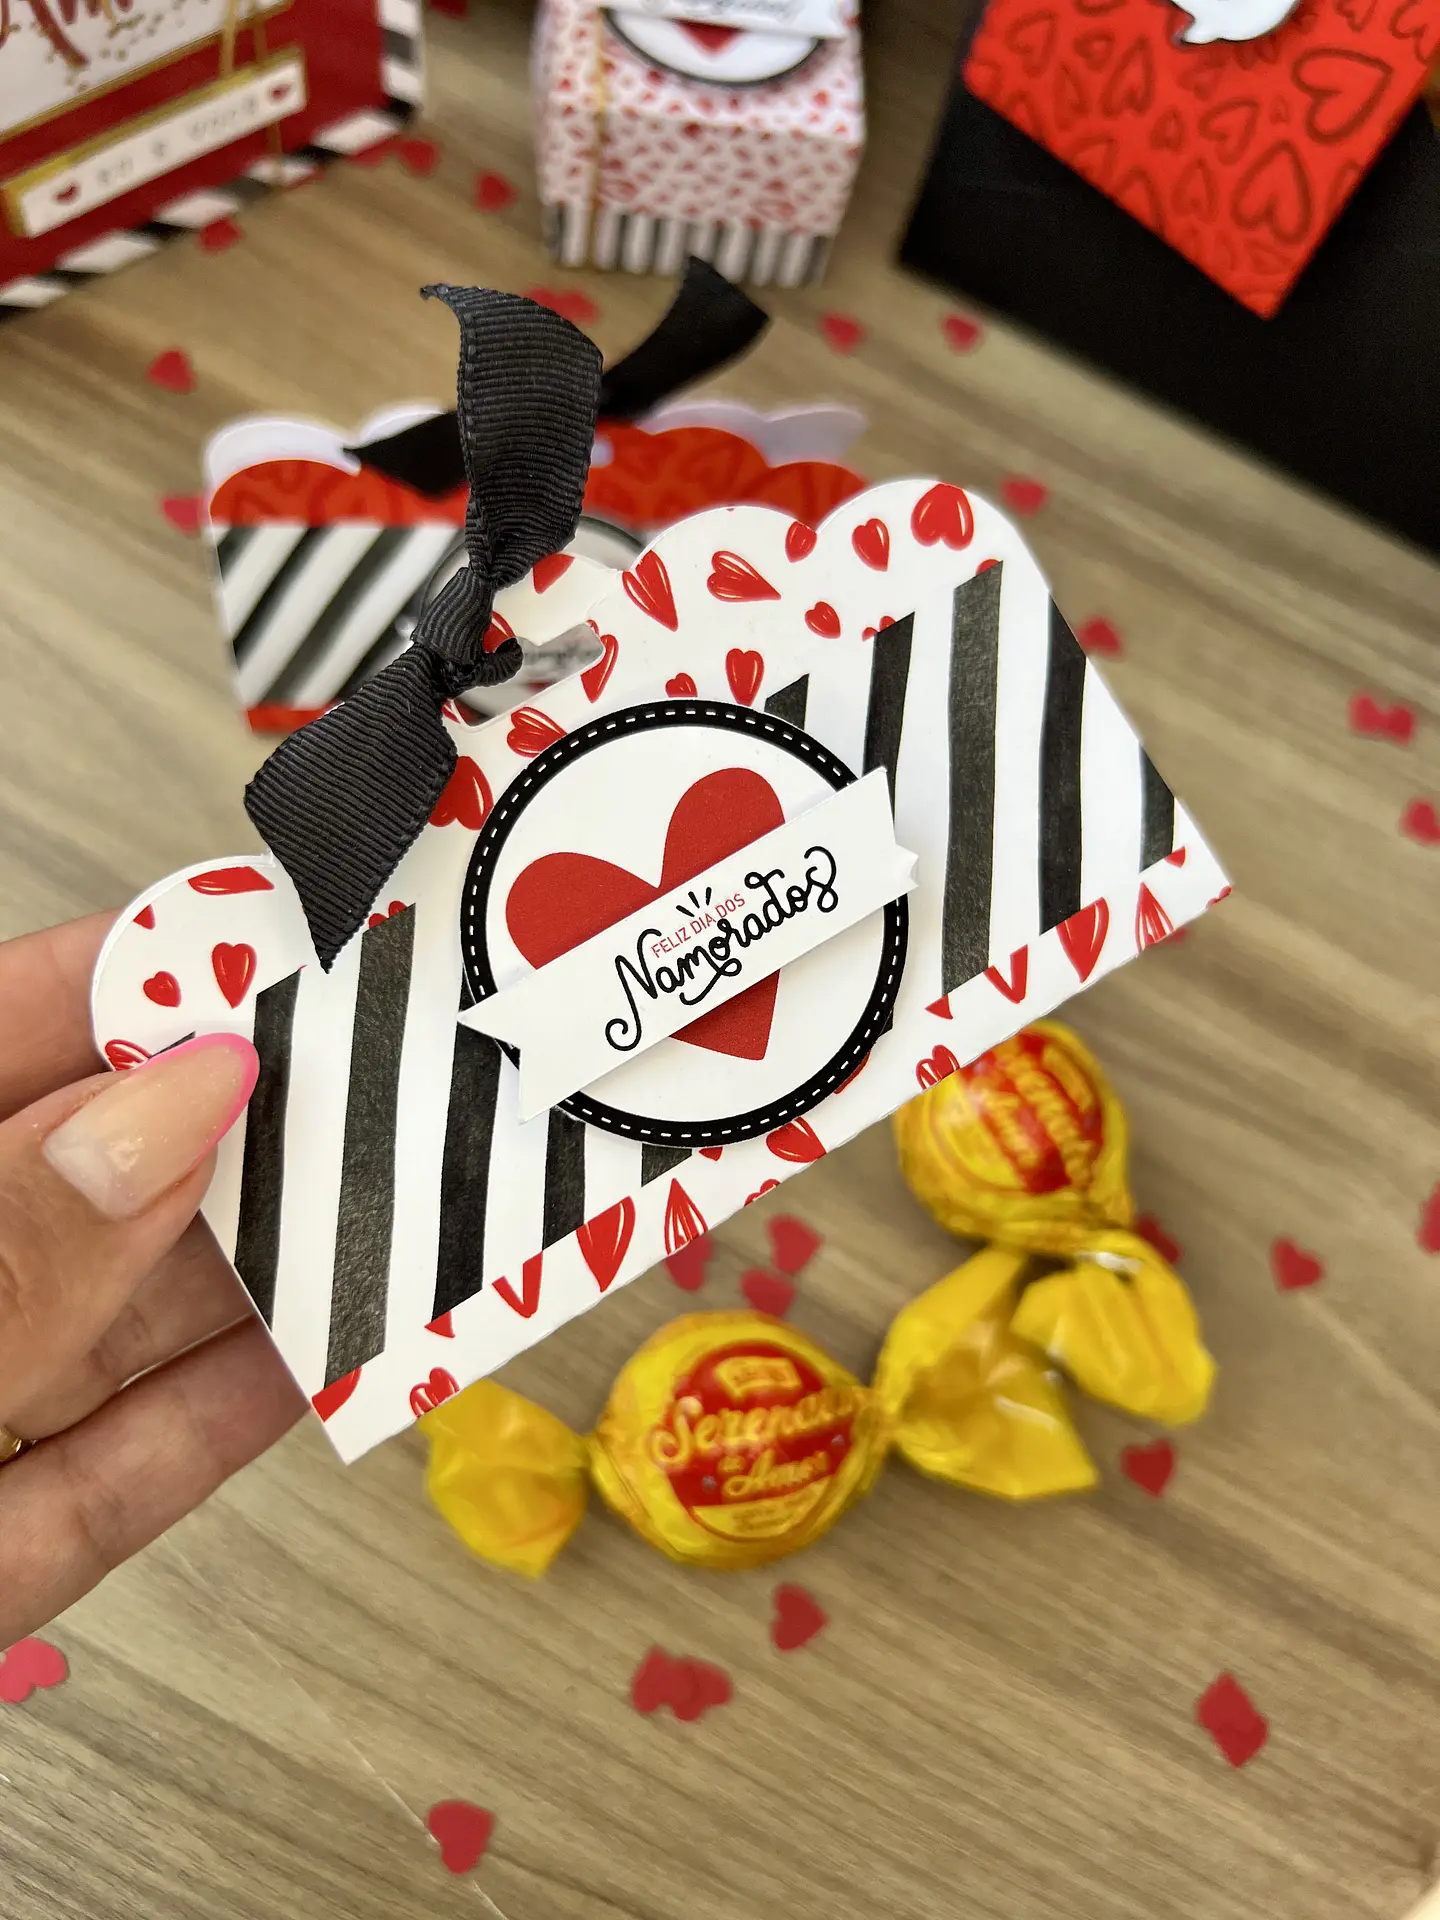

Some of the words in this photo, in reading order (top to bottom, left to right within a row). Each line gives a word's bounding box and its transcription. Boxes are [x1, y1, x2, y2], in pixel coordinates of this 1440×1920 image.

[604, 845, 839, 1052] Namorados
[651, 927, 692, 958] FELIZ
[690, 912, 716, 935] DIA
[716, 893, 746, 920] DOS
